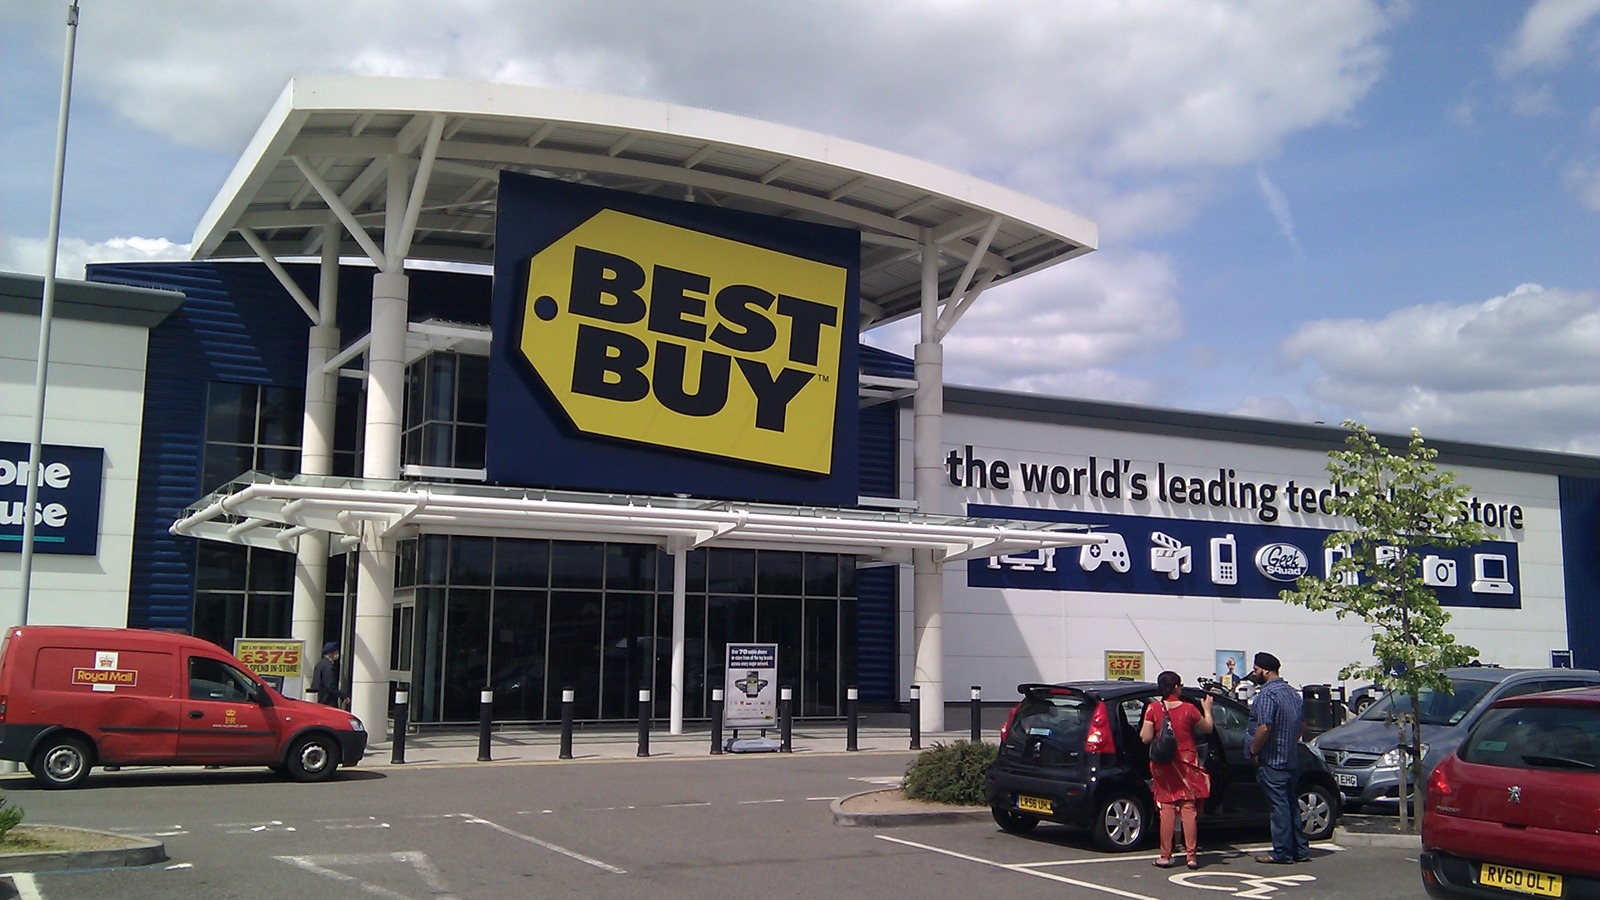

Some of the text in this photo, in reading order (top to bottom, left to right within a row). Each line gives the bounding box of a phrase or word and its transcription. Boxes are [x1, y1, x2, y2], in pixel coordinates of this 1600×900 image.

[568, 245, 838, 366] BEST
[571, 323, 817, 433] BUY
[946, 445, 1010, 490] the
[1021, 456, 1149, 501] world's
[1158, 462, 1278, 522] leading
[1456, 497, 1524, 530] store
[1268, 546, 1300, 568] Geek
[1266, 565, 1302, 576] Squad
[241, 651, 298, 665] £375
[1109, 659, 1141, 669] £375
[250, 664, 270, 673] SPEND
[270, 664, 298, 673] IN-STORE
[78, 671, 133, 682] Royal Mail
[1341, 775, 1356, 785] EHG
[1487, 866, 1523, 885] RV60
